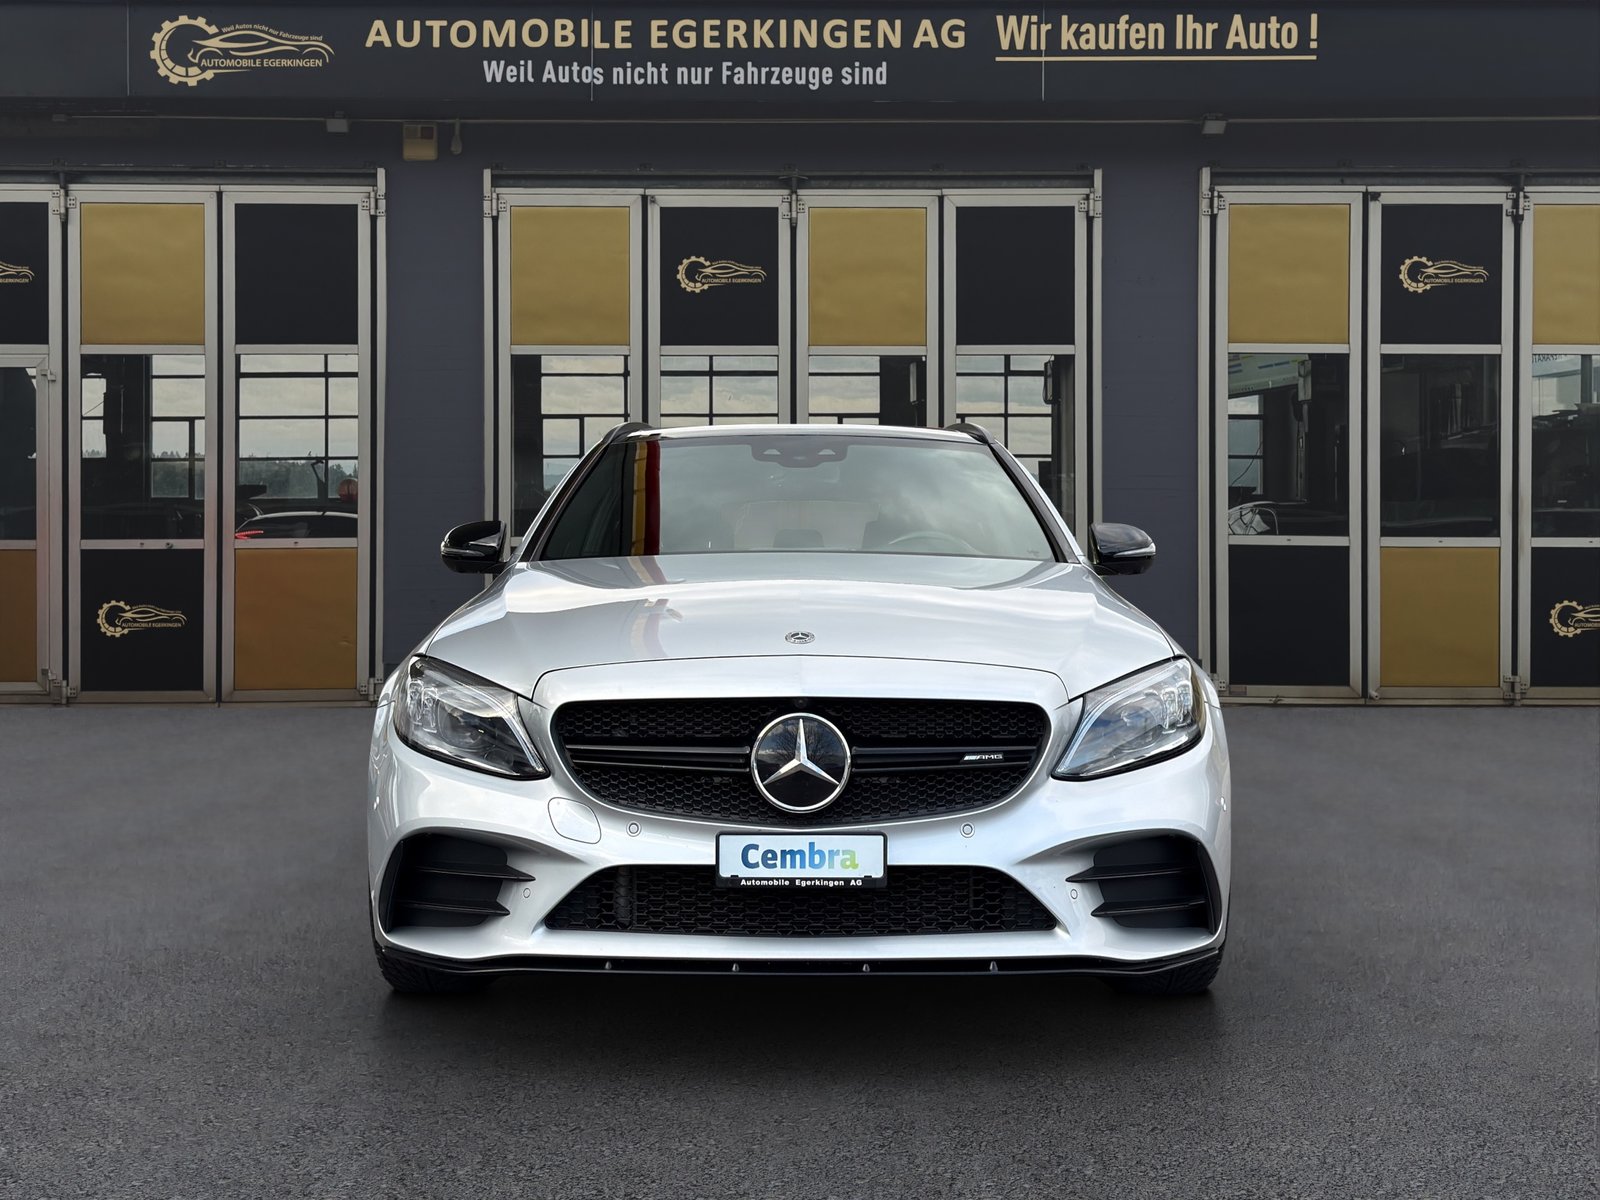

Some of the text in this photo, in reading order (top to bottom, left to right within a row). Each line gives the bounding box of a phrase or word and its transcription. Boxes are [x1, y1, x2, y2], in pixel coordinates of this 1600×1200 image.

[221, 25, 235, 33] Weil
[253, 24, 268, 32] nicht
[269, 28, 279, 36] nur
[279, 31, 309, 41] Fahrzeuge
[365, 18, 966, 49] AUTOMOBILE EGERKINGEN AG
[996, 15, 1052, 50] Wir
[1061, 14, 1165, 50] kaufen
[1176, 14, 1218, 50] Ihr
[1226, 14, 1299, 50] Auto
[200, 59, 323, 67] AUTOMOBILE EGERKINGEN
[483, 60, 887, 90] Weil Autos nicht nur Fahrzeuge sind
[741, 842, 859, 870] Cembra
[795, 879, 845, 887] Egerkingen
